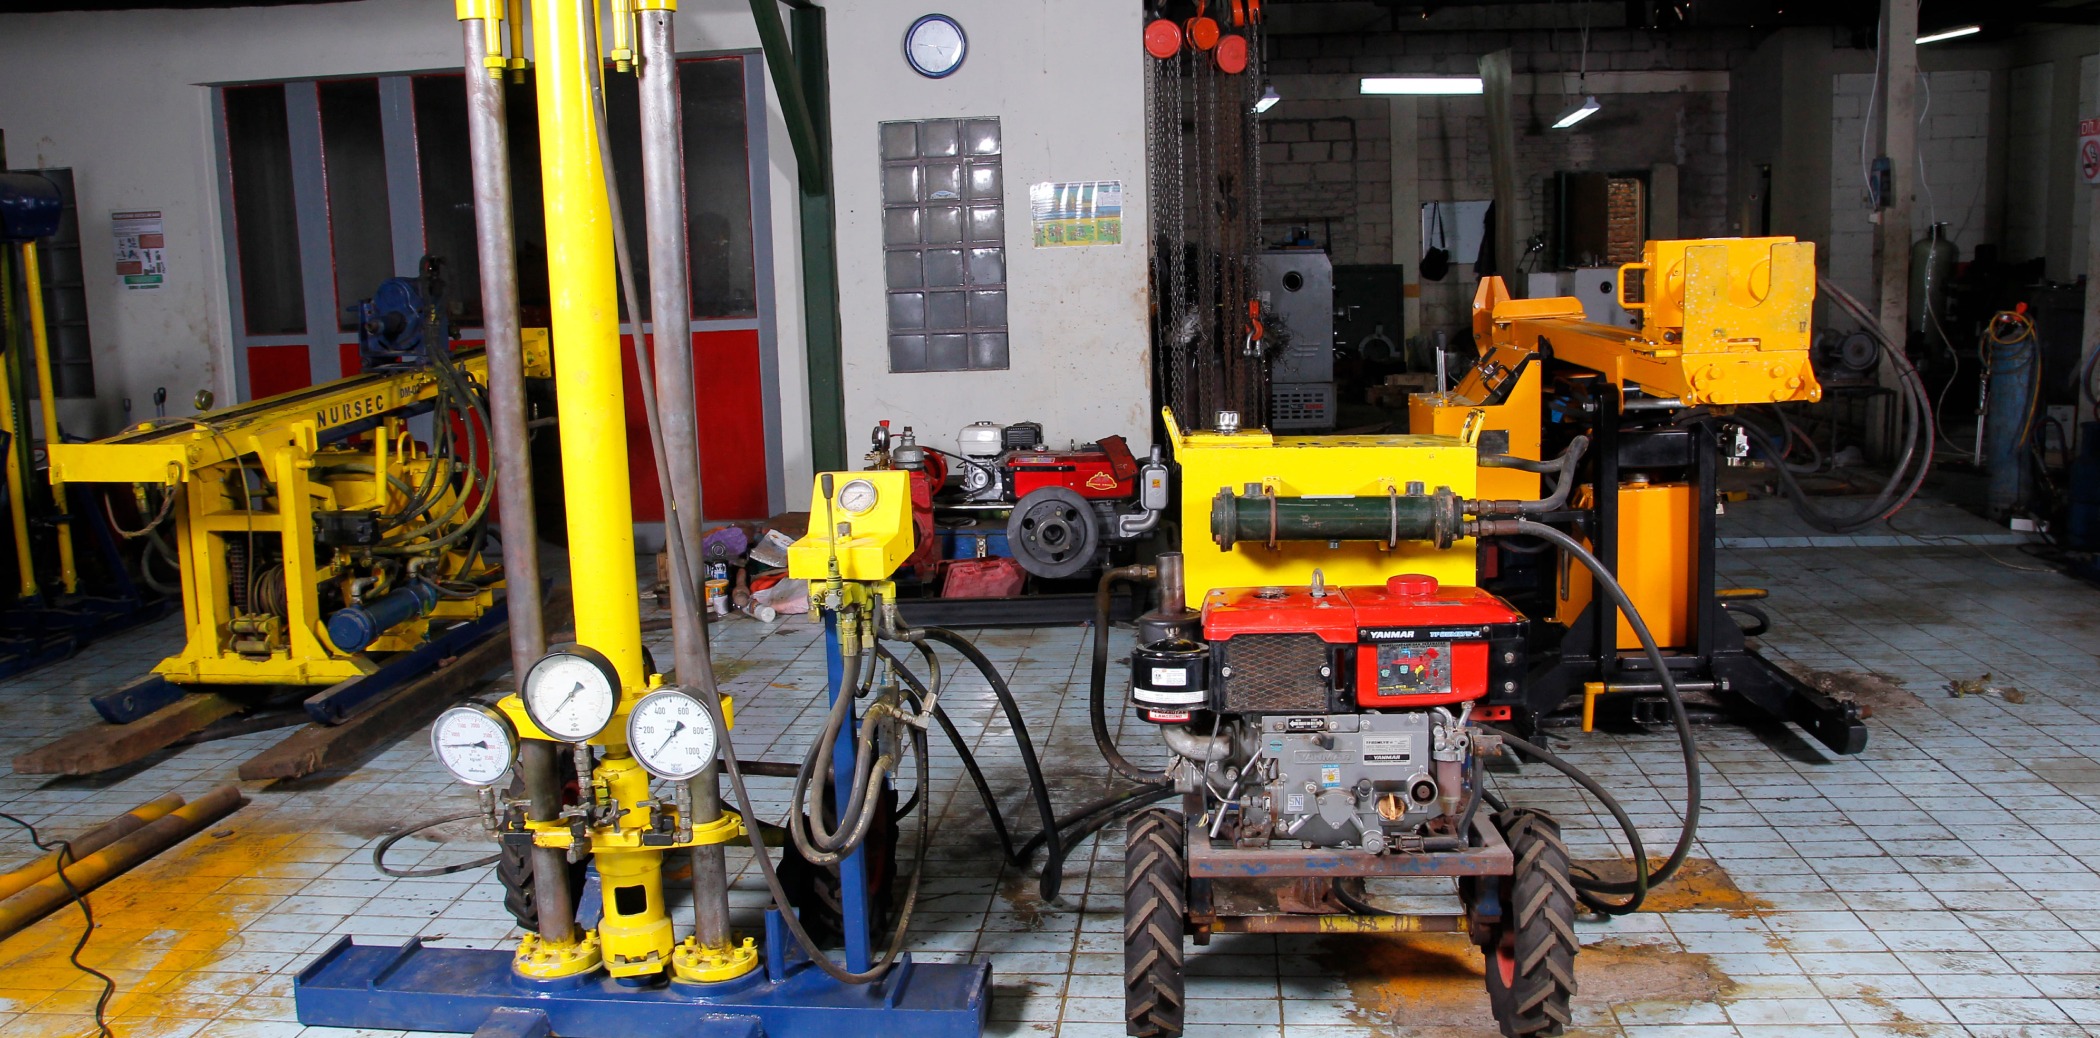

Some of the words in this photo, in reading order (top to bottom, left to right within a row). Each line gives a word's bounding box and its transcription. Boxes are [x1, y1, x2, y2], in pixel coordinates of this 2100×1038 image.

[316, 395, 384, 428] NURSEC
[1370, 630, 1415, 639] YANMAR
[654, 706, 666, 715] 400
[677, 707, 690, 715] 600
[643, 726, 655, 734] 200
[692, 726, 705, 735] 800
[685, 747, 700, 755] 1000
[1289, 796, 1303, 806] SNI
